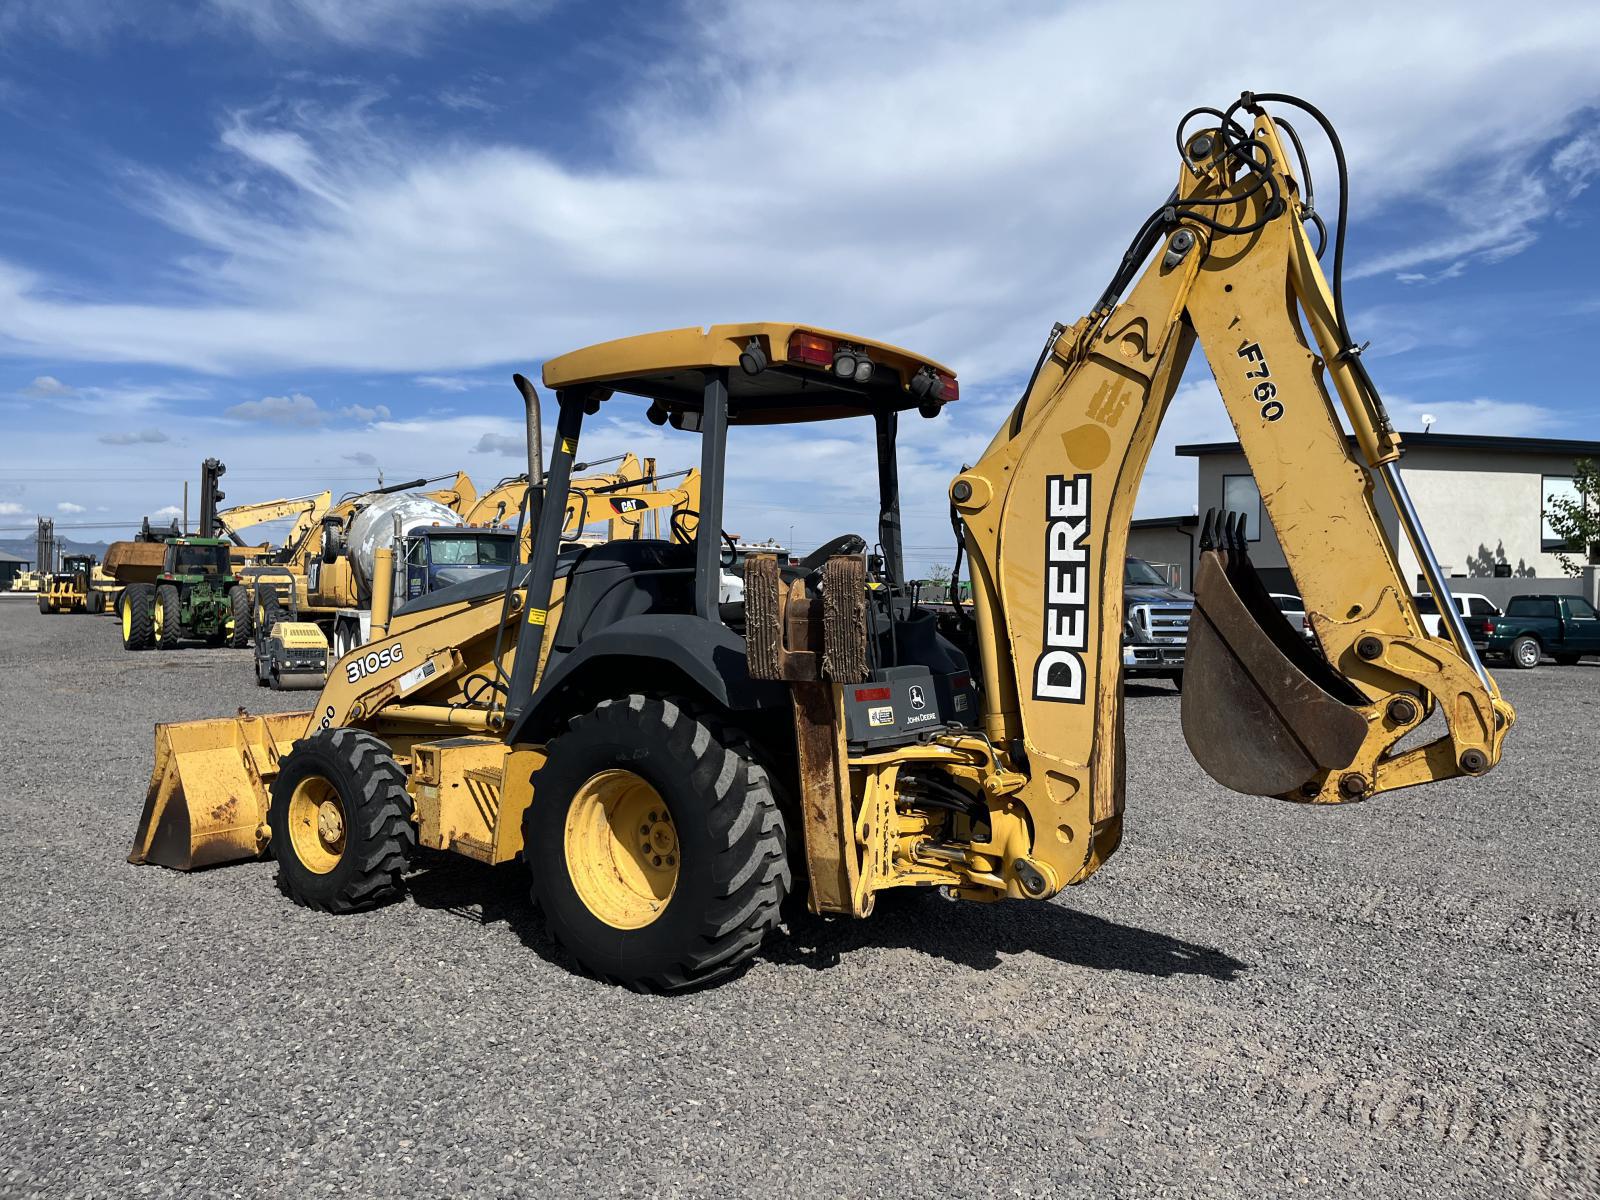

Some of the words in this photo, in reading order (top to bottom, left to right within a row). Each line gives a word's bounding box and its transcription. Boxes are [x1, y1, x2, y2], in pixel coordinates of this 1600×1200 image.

[1237, 342, 1285, 421] F760
[621, 500, 637, 512] CAT
[1032, 473, 1092, 704] DEERE
[346, 643, 403, 683] 310SG
[316, 705, 335, 730] 60
[907, 716, 920, 724] JOHN
[920, 713, 936, 721] DEERE
